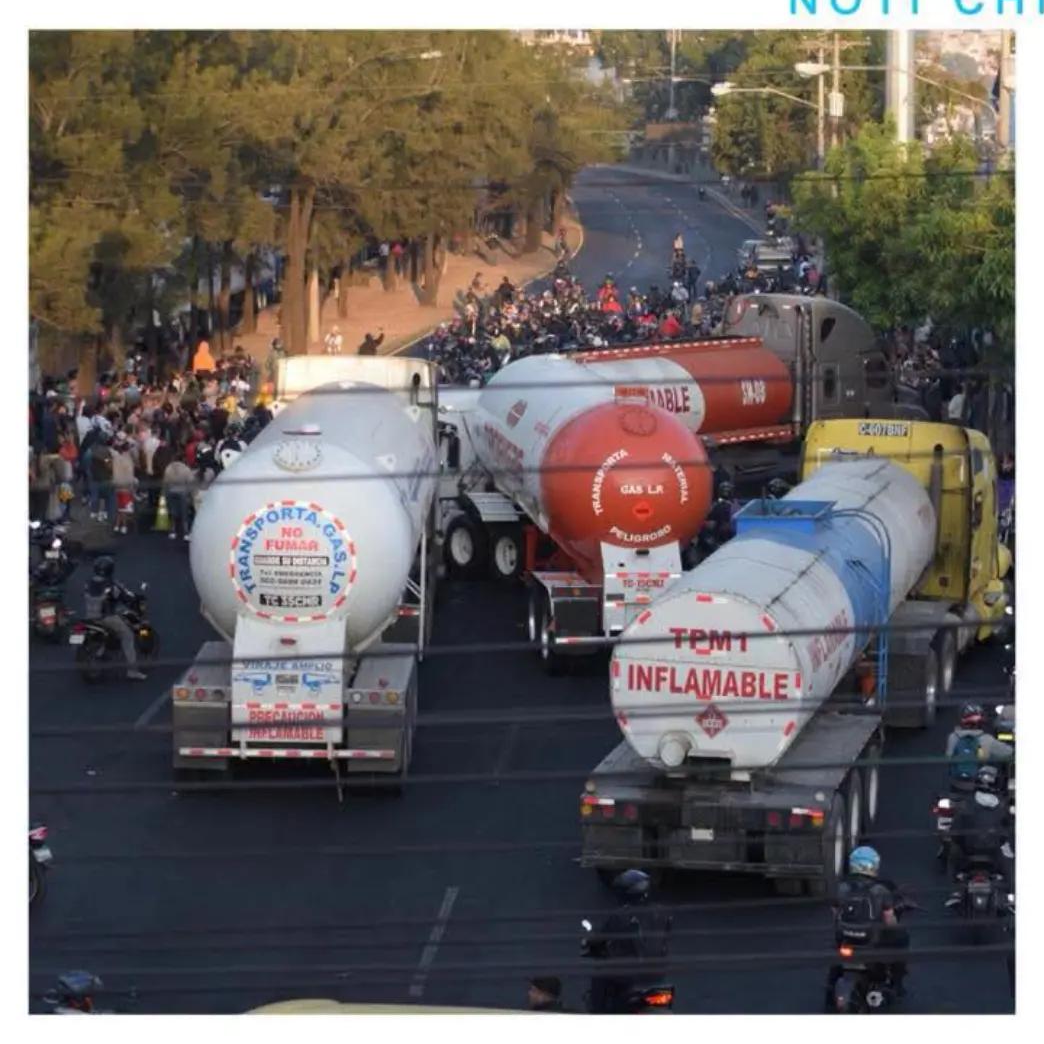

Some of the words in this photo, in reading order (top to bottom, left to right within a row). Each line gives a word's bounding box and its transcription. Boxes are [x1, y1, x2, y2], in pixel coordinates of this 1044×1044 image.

[620, 484, 643, 494] GAS
[281, 527, 303, 538] NO
[610, 524, 671, 542] PELIGROSO
[265, 540, 318, 552] FUMAR
[628, 664, 789, 700] INFLAMABLE
[249, 711, 325, 724] PRECAUCION
